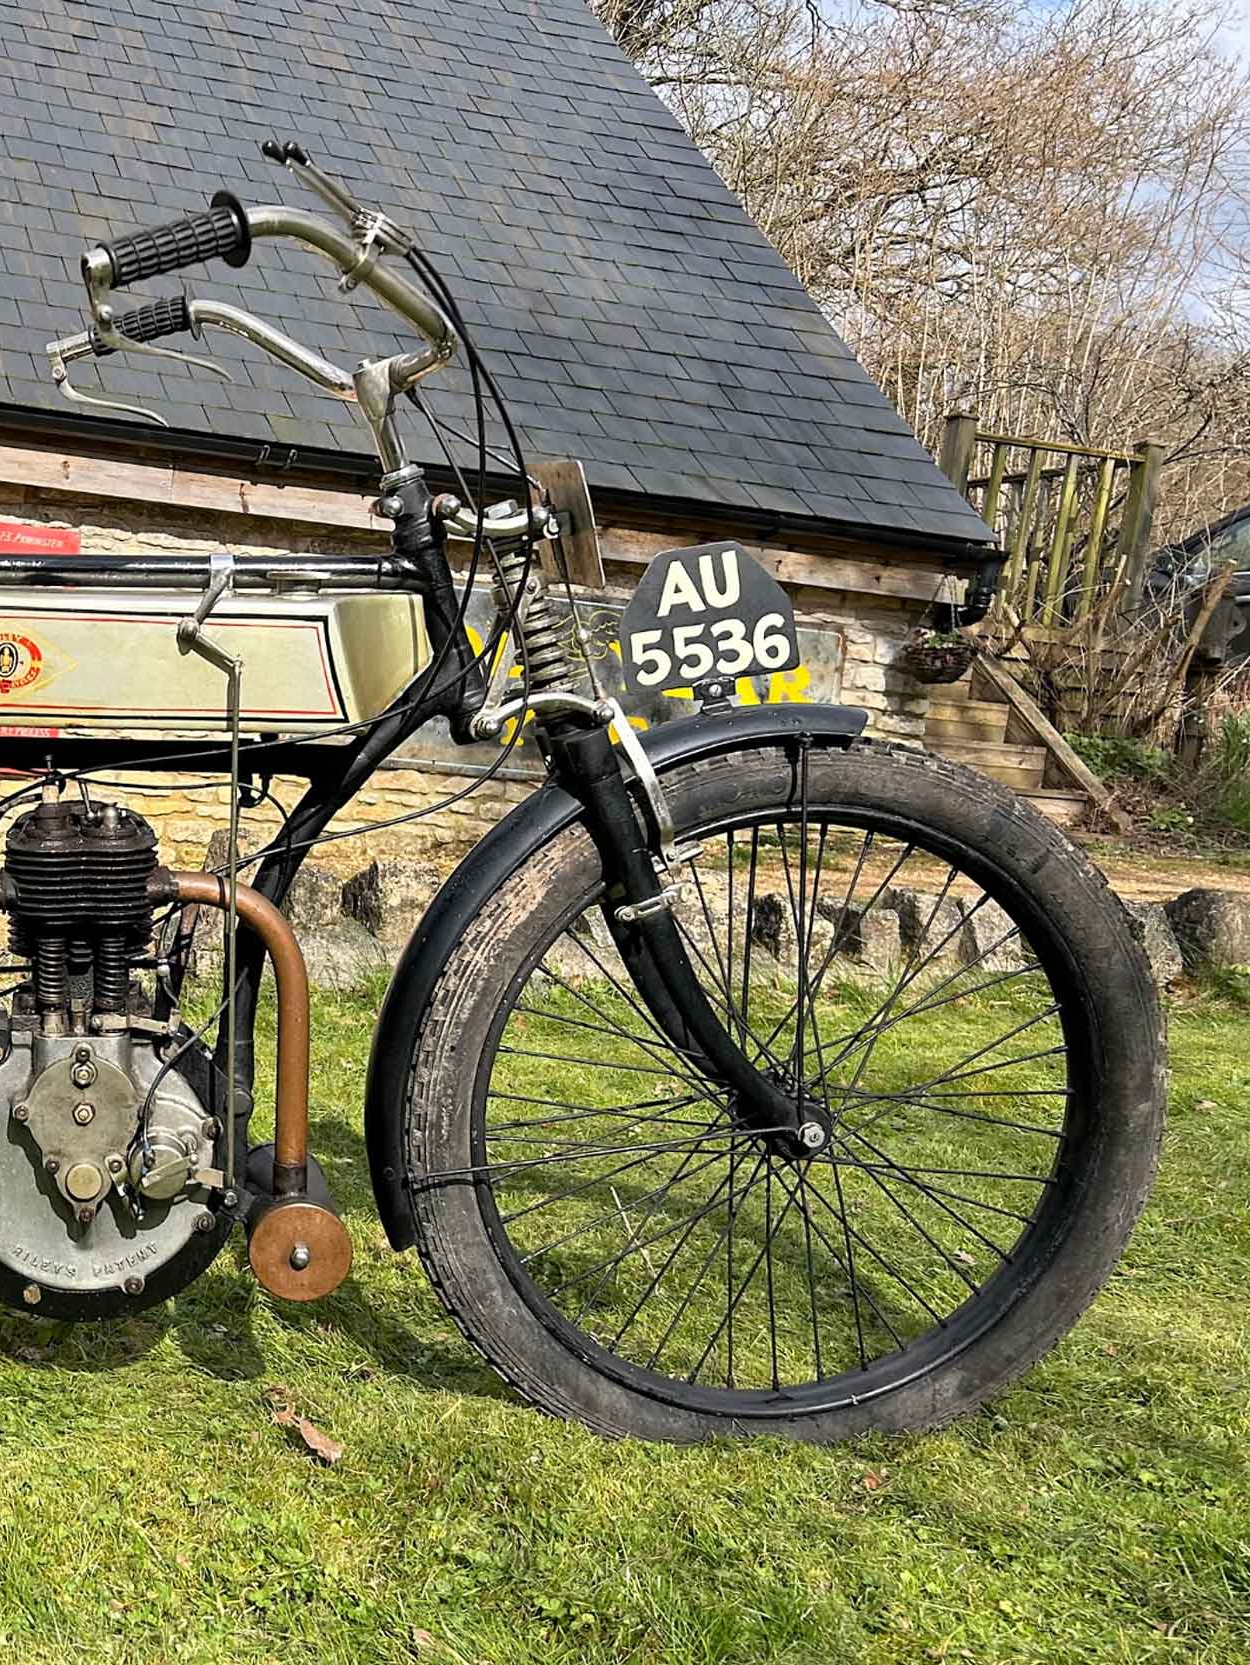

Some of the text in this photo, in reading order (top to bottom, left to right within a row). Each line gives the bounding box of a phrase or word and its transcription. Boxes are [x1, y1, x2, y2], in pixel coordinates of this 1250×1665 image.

[657, 549, 741, 618] AU
[630, 612, 792, 687] 5536
[92, 1241, 159, 1279] PATENT
